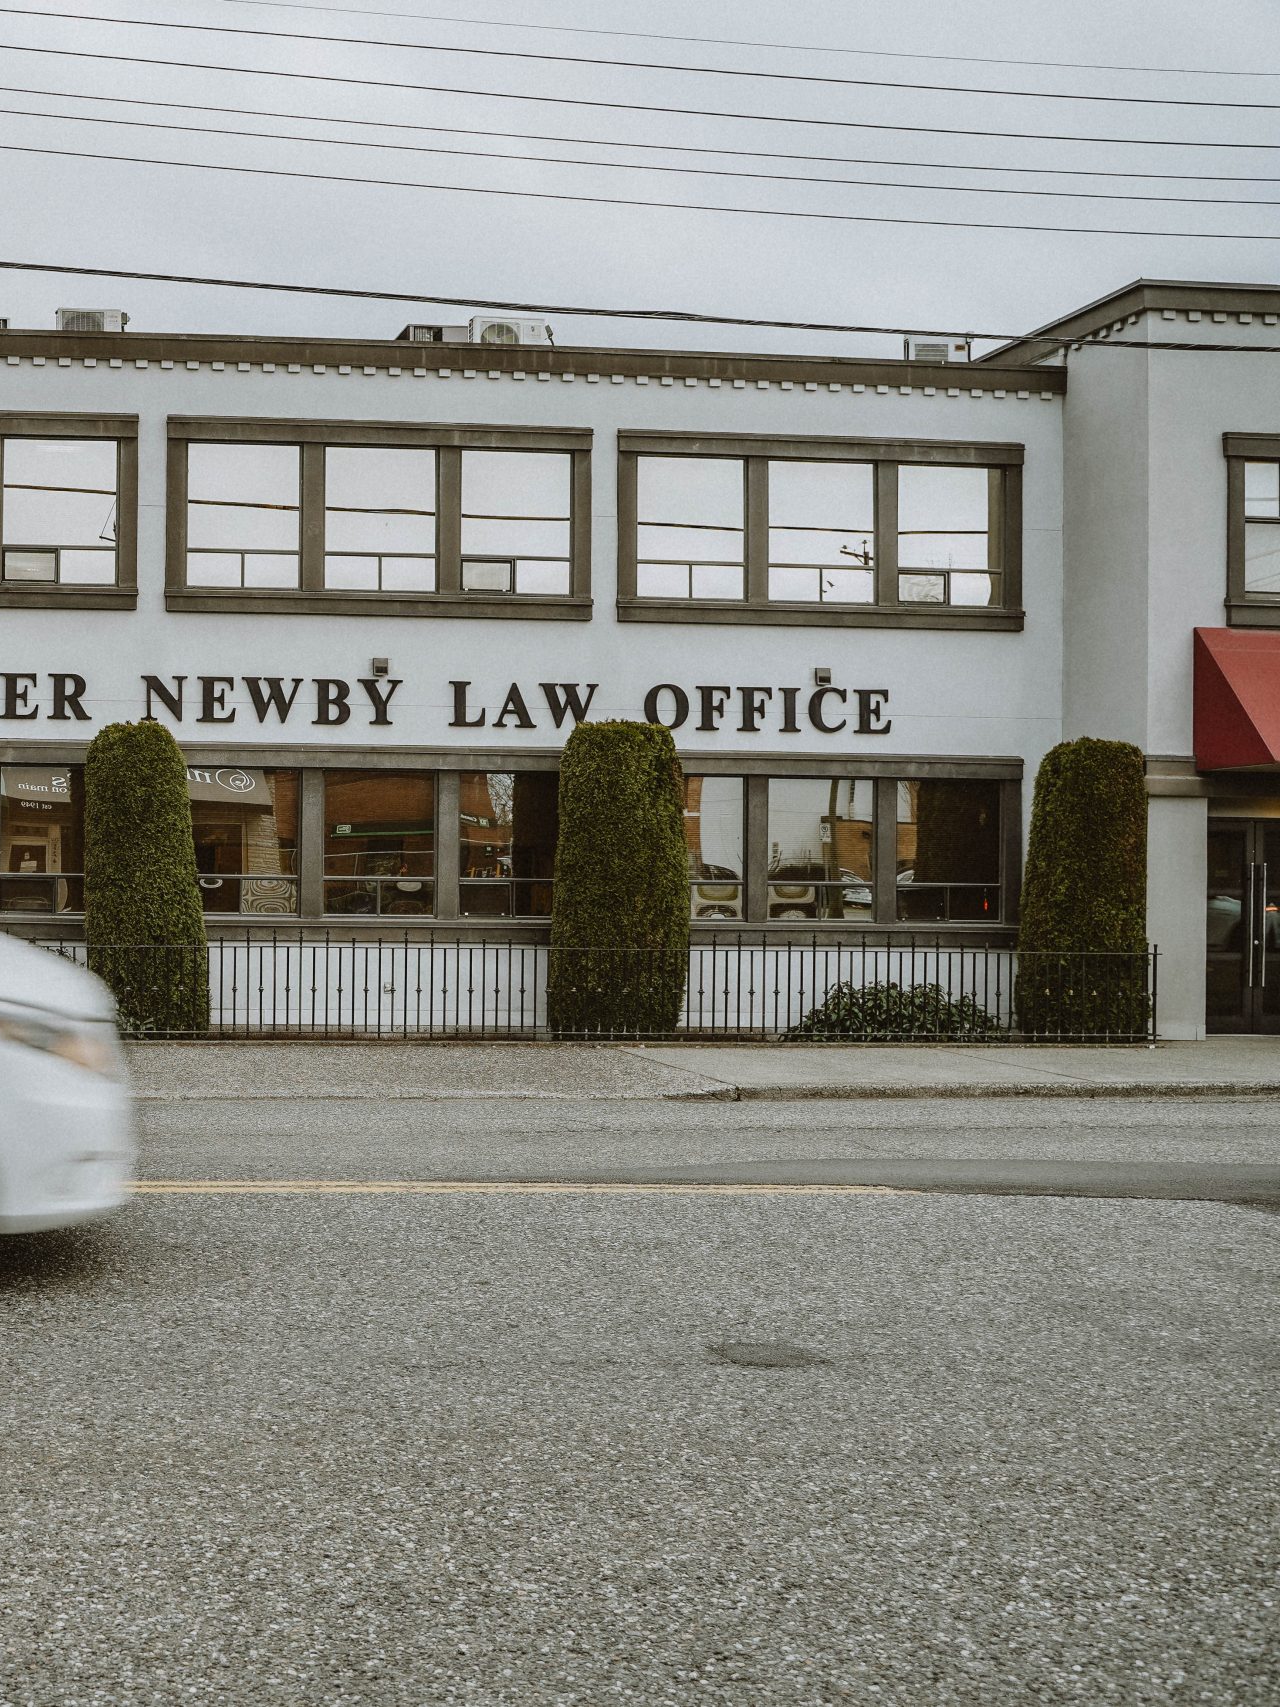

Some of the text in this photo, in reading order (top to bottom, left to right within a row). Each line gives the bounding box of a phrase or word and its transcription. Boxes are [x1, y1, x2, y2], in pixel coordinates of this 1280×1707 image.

[140, 675, 404, 726] NEWBY
[448, 680, 600, 730] LAW
[643, 683, 893, 735] OFFICE
